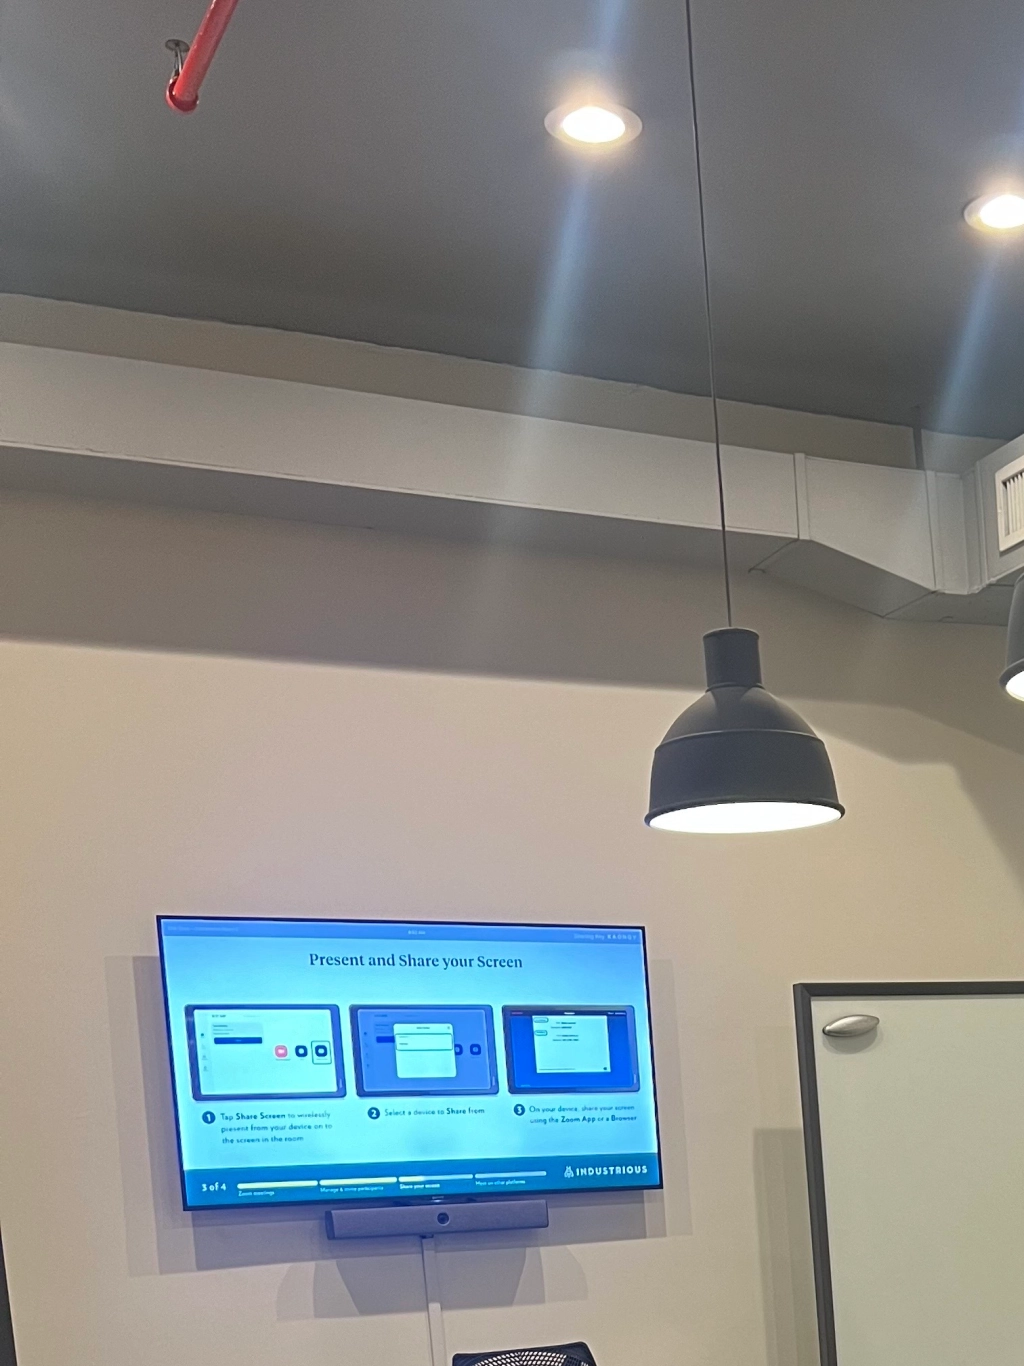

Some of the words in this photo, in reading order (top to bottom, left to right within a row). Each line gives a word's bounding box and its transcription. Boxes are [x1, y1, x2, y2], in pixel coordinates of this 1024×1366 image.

[309, 953, 364, 966] Present
[368, 954, 395, 966] and
[400, 954, 439, 967] Share
[442, 956, 474, 970] your
[477, 956, 523, 968] Screen
[220, 1112, 233, 1121] Tap
[297, 1111, 330, 1119] wirelessly
[576, 1165, 648, 1176] INDUSTRIOUS
[202, 1183, 207, 1191] 3
[209, 1182, 219, 1191] of
[220, 1183, 226, 1191] 4
